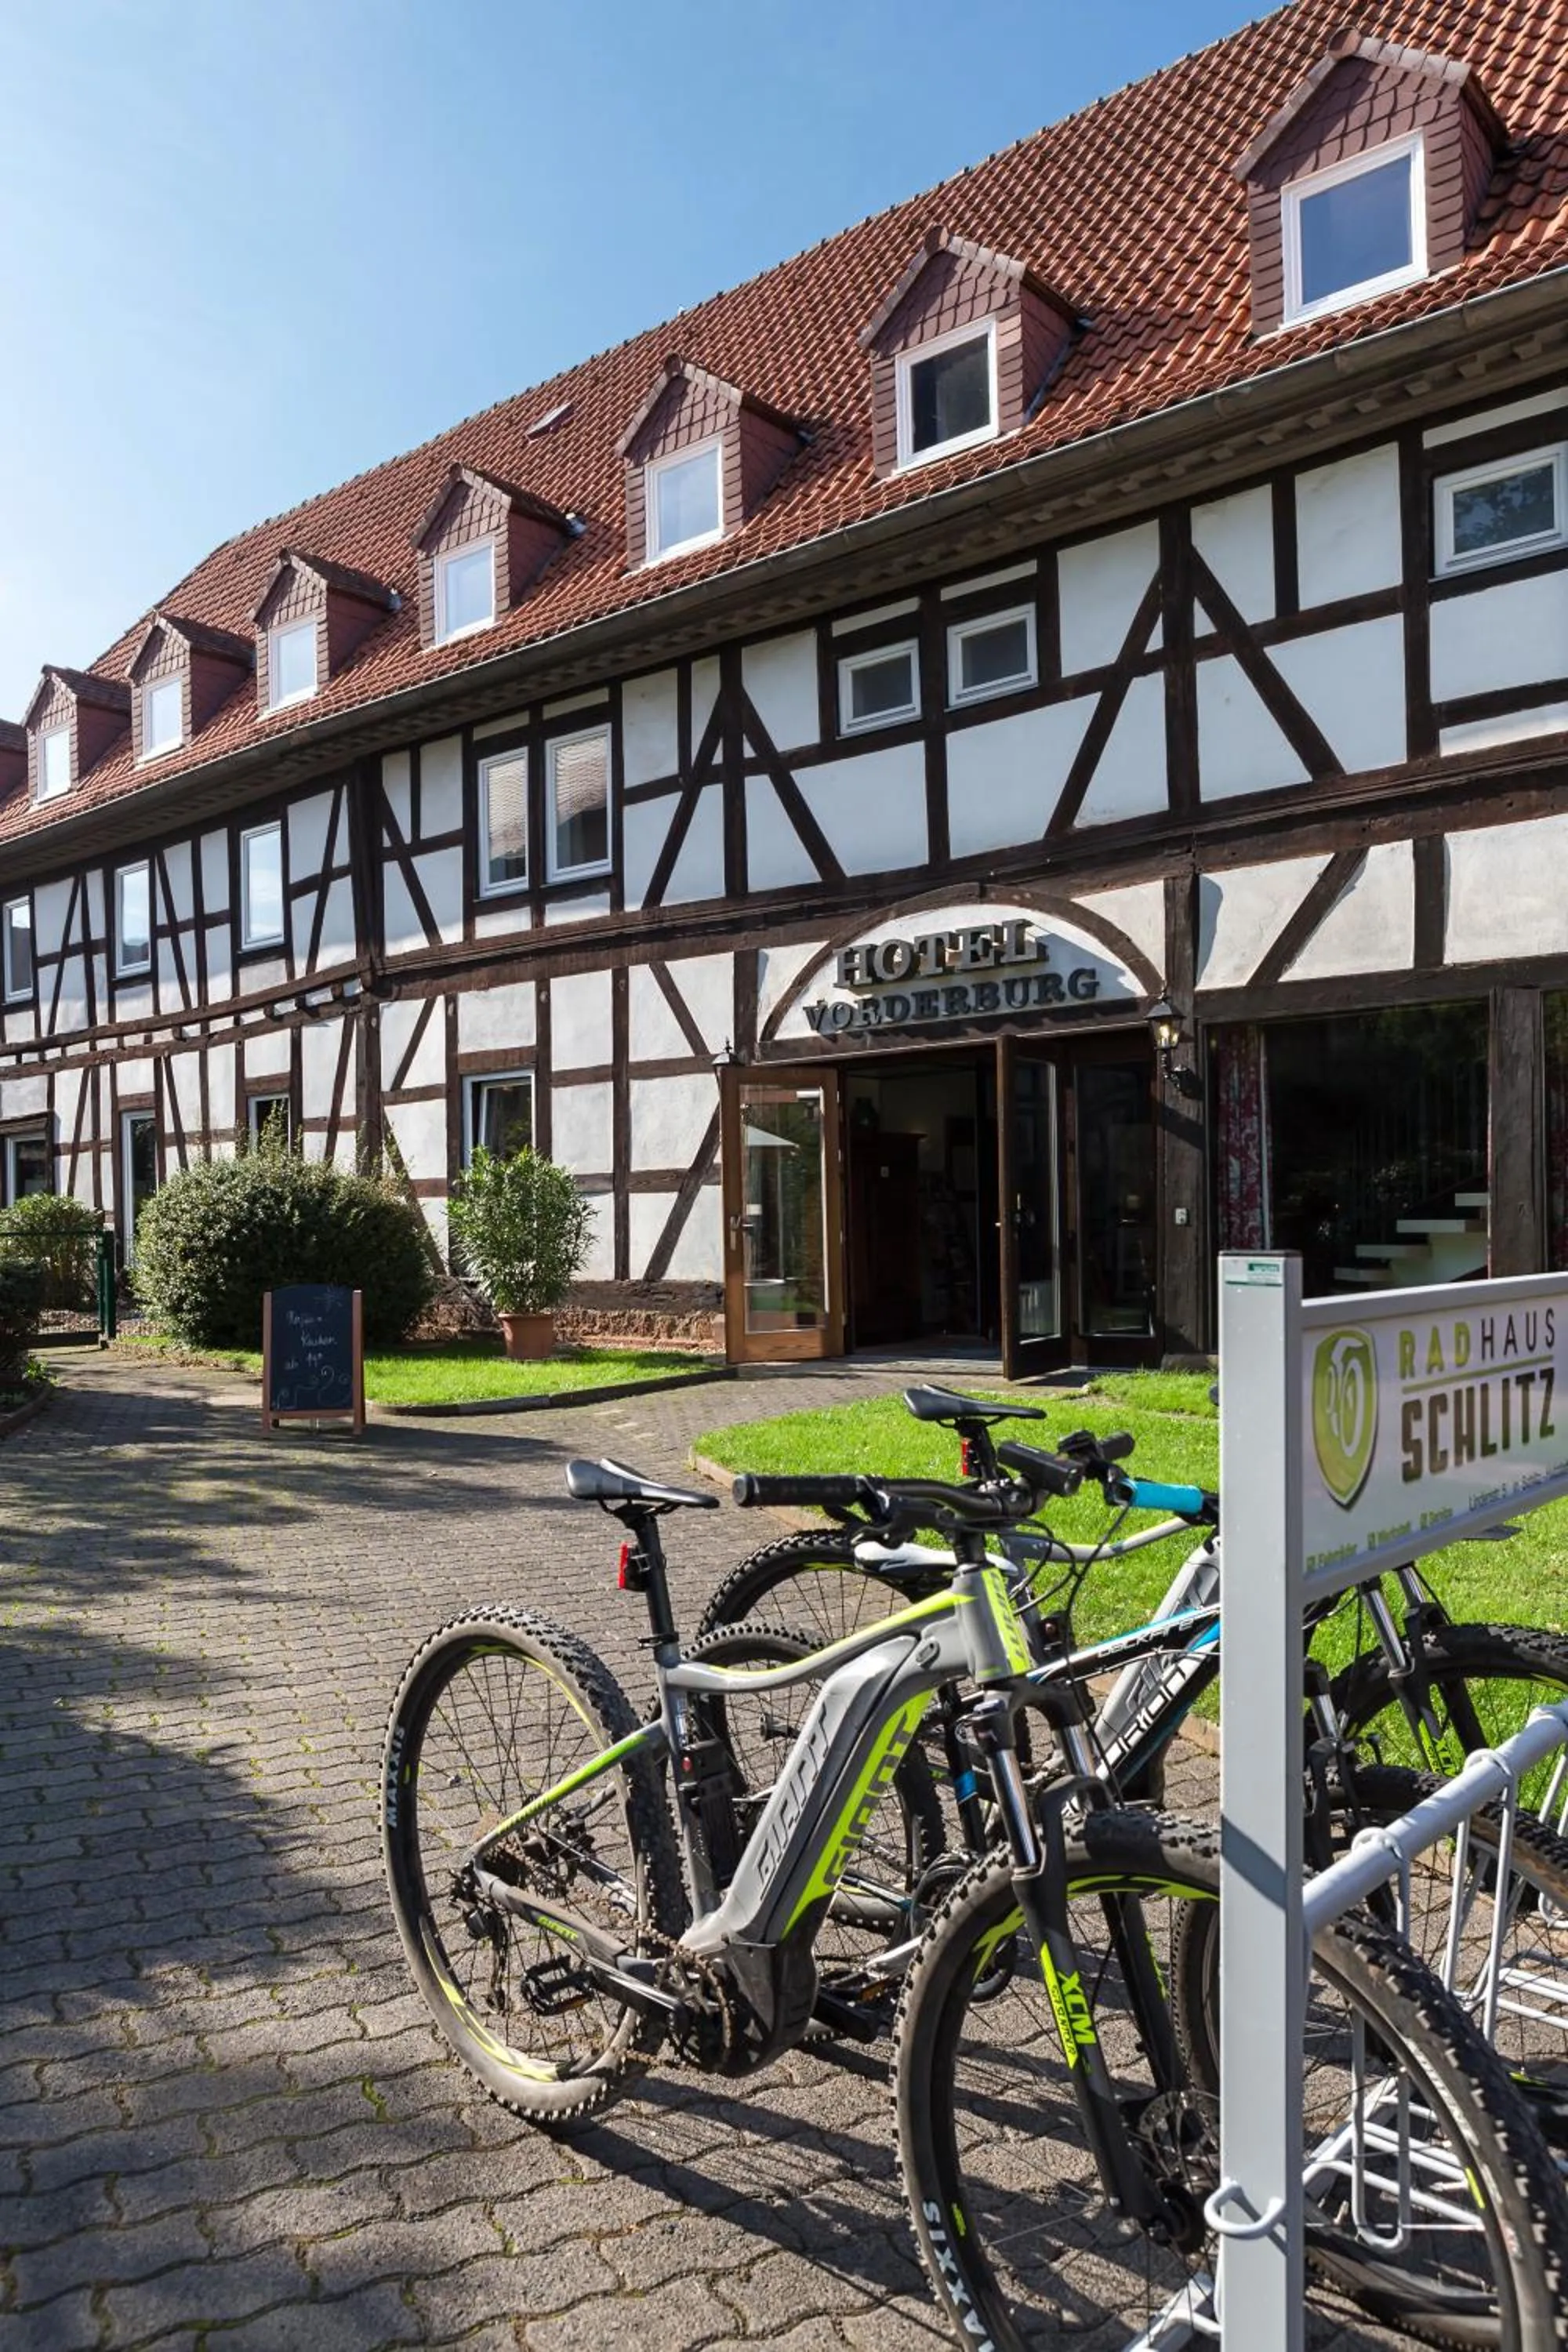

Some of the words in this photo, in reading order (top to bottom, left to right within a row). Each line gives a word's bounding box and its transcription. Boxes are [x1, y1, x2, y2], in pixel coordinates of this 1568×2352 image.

[803, 968, 1100, 1033] VORDERBURG
[833, 919, 1047, 989] HOTEL
[1402, 1367, 1555, 1484] SCHLITZ
[387, 1726, 405, 1829] MAXXIS
[757, 1700, 829, 1900] GIANT
[823, 1710, 914, 1886] GIANT
[1057, 1970, 1097, 2045] XCM
